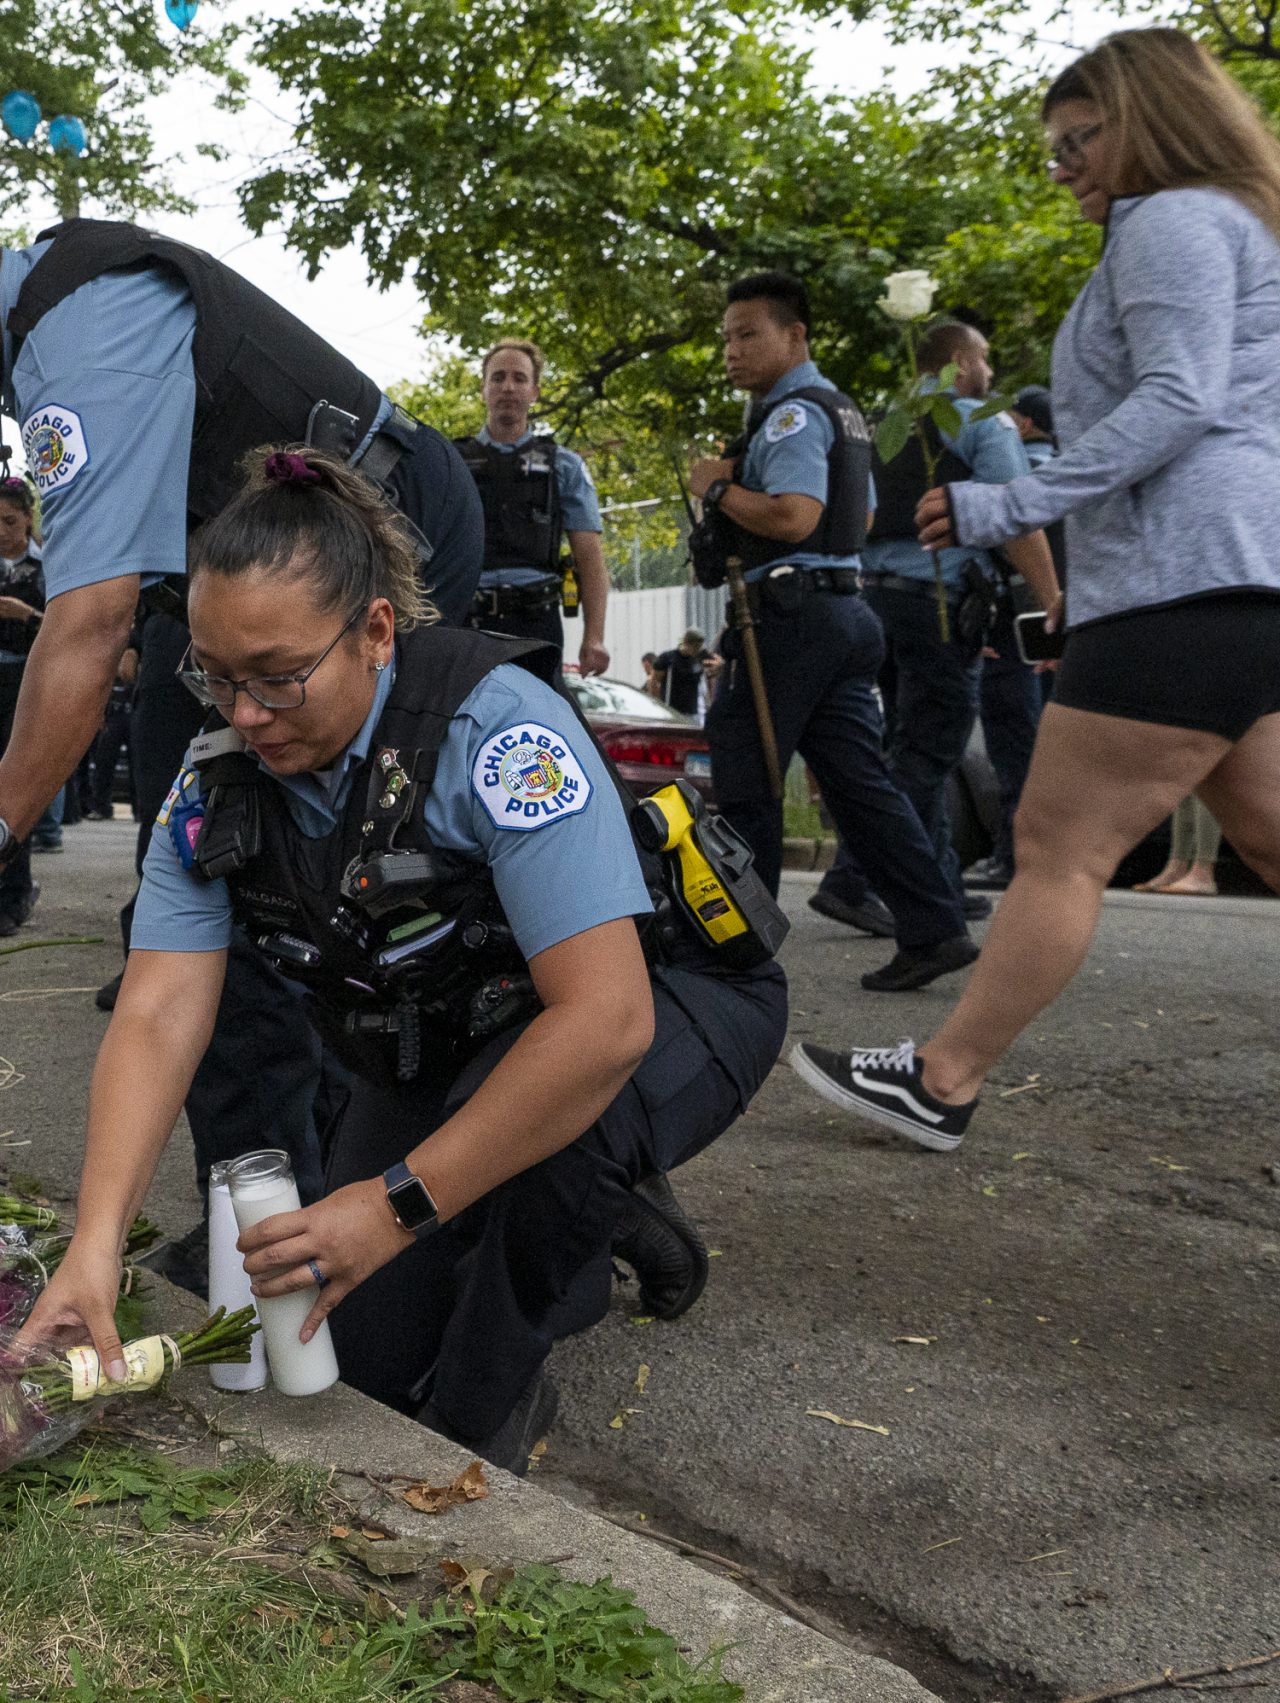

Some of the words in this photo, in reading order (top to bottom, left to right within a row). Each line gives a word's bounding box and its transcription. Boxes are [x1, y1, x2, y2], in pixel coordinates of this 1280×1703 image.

[24, 413, 73, 459] CHICAGO
[34, 452, 76, 488] POLICE
[192, 742, 213, 754] TIME:
[483, 731, 566, 787] CHICAGO
[504, 775, 579, 818] POLICE
